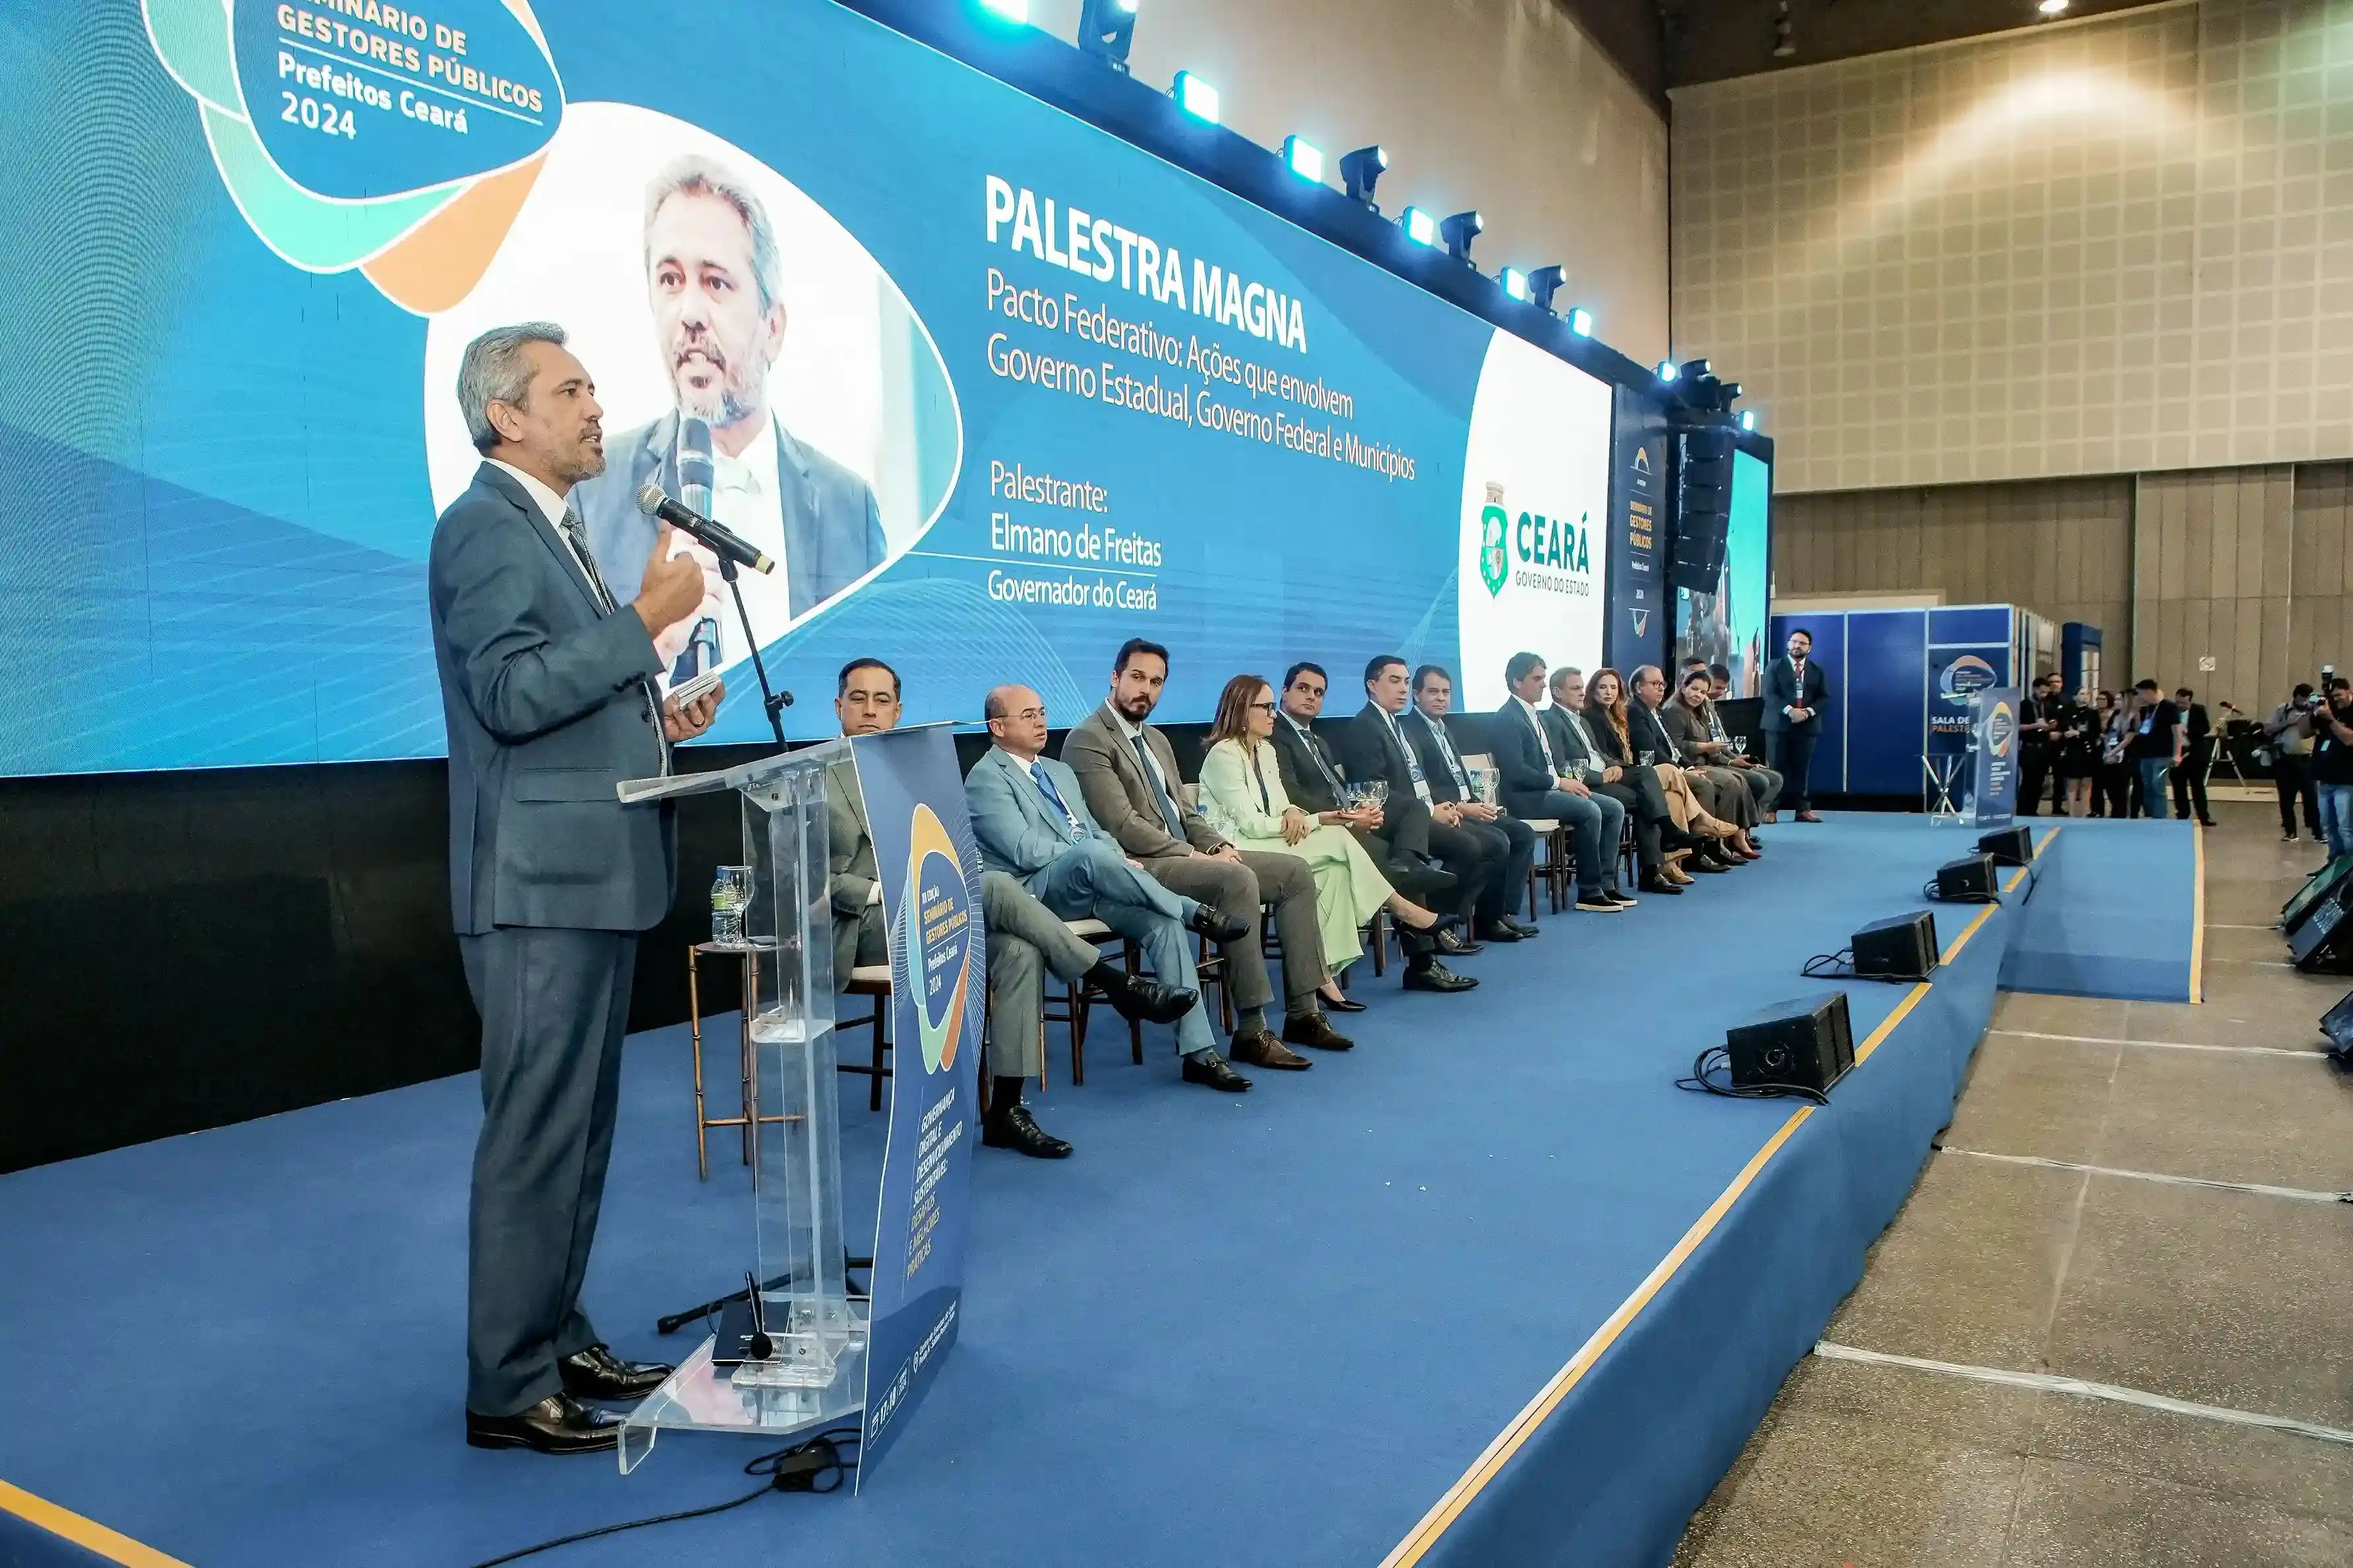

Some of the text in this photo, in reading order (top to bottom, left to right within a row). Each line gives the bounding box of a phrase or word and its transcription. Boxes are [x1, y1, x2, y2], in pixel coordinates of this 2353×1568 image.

[277, 3, 543, 112] GESTORES PÚBLICOS
[435, 23, 467, 55] DE
[278, 51, 468, 134] Prefeitos Ceará
[282, 92, 356, 139] 2024
[986, 175, 1306, 353] PALESTRA MAGNA
[988, 268, 1353, 419] Pacto Federativo: Ações que envolvem
[987, 333, 1415, 483] Governo Estadual, Governo Federal e Municípios
[991, 460, 1109, 512] Palestrante:
[991, 512, 1162, 567] Elmano de Freitas
[1517, 510, 1589, 575] CEARÁ
[988, 570, 1157, 611] Governador do Ceará
[1515, 570, 1589, 597] GOVERNO DO ESTADO
[926, 909, 968, 945] GESTORES PÚBLICOS
[948, 897, 954, 912] DE
[928, 941, 958, 973] Prefeitos Ceará
[929, 973, 942, 996] 2024
[921, 1087, 955, 1133] GOVERNANÇA
[915, 1120, 962, 1184] DESENVOLVIMENTO
[919, 1120, 942, 1159] DIGITAL E
